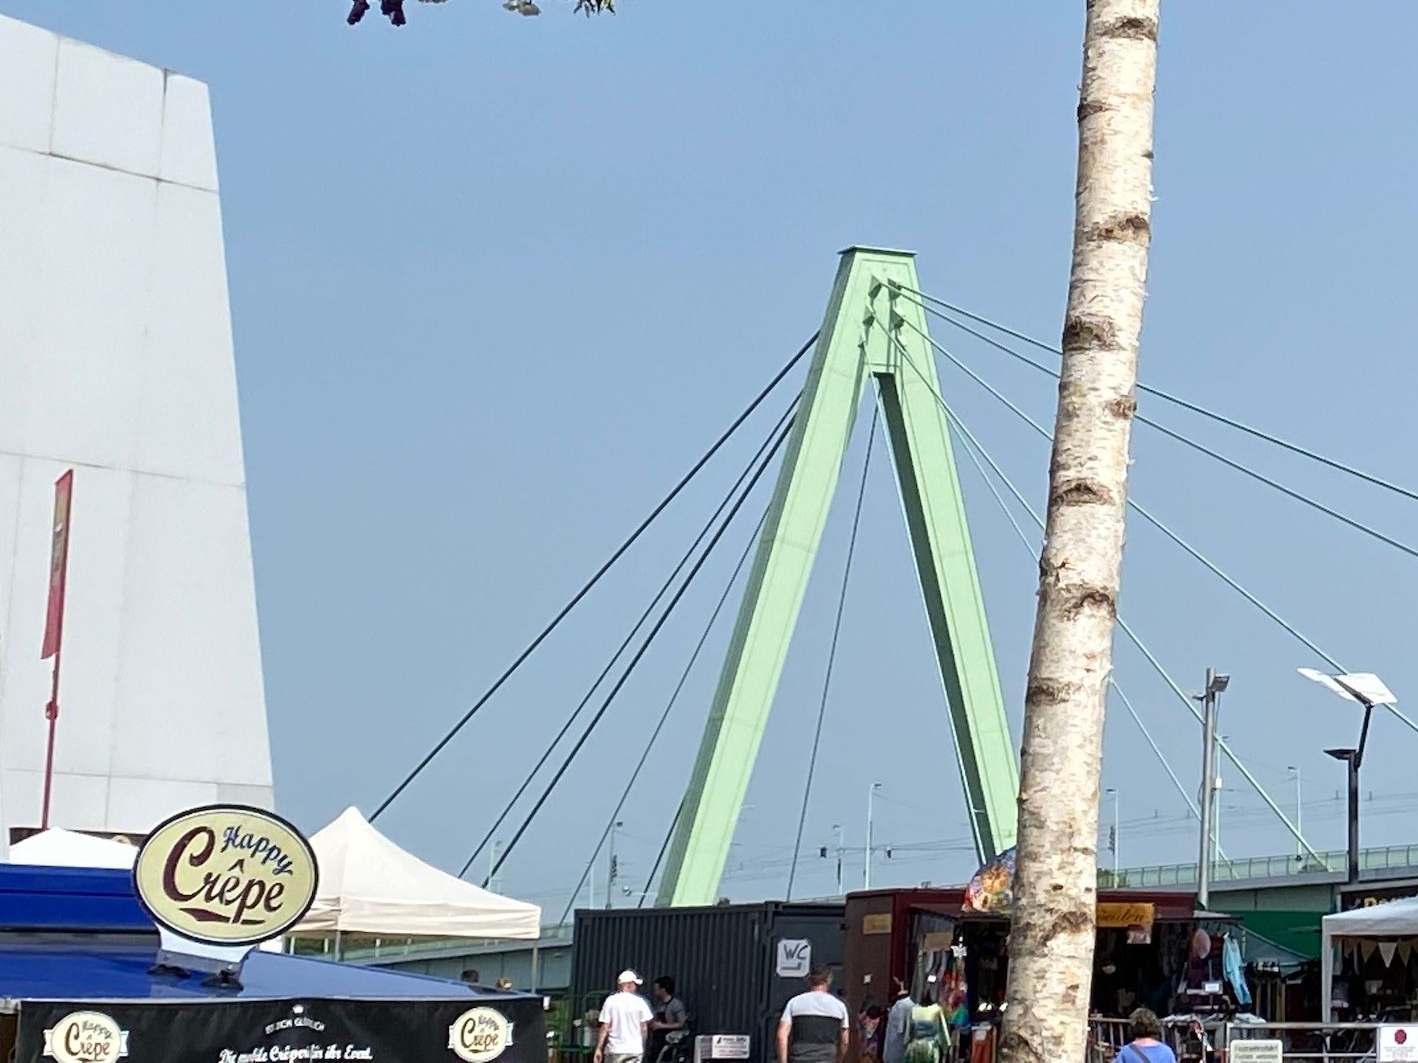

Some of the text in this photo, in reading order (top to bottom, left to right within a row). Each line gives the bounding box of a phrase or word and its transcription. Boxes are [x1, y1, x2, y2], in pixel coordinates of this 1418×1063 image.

[162, 825, 285, 925] Crêpe
[219, 824, 294, 876] Happy
[783, 942, 809, 961] WC
